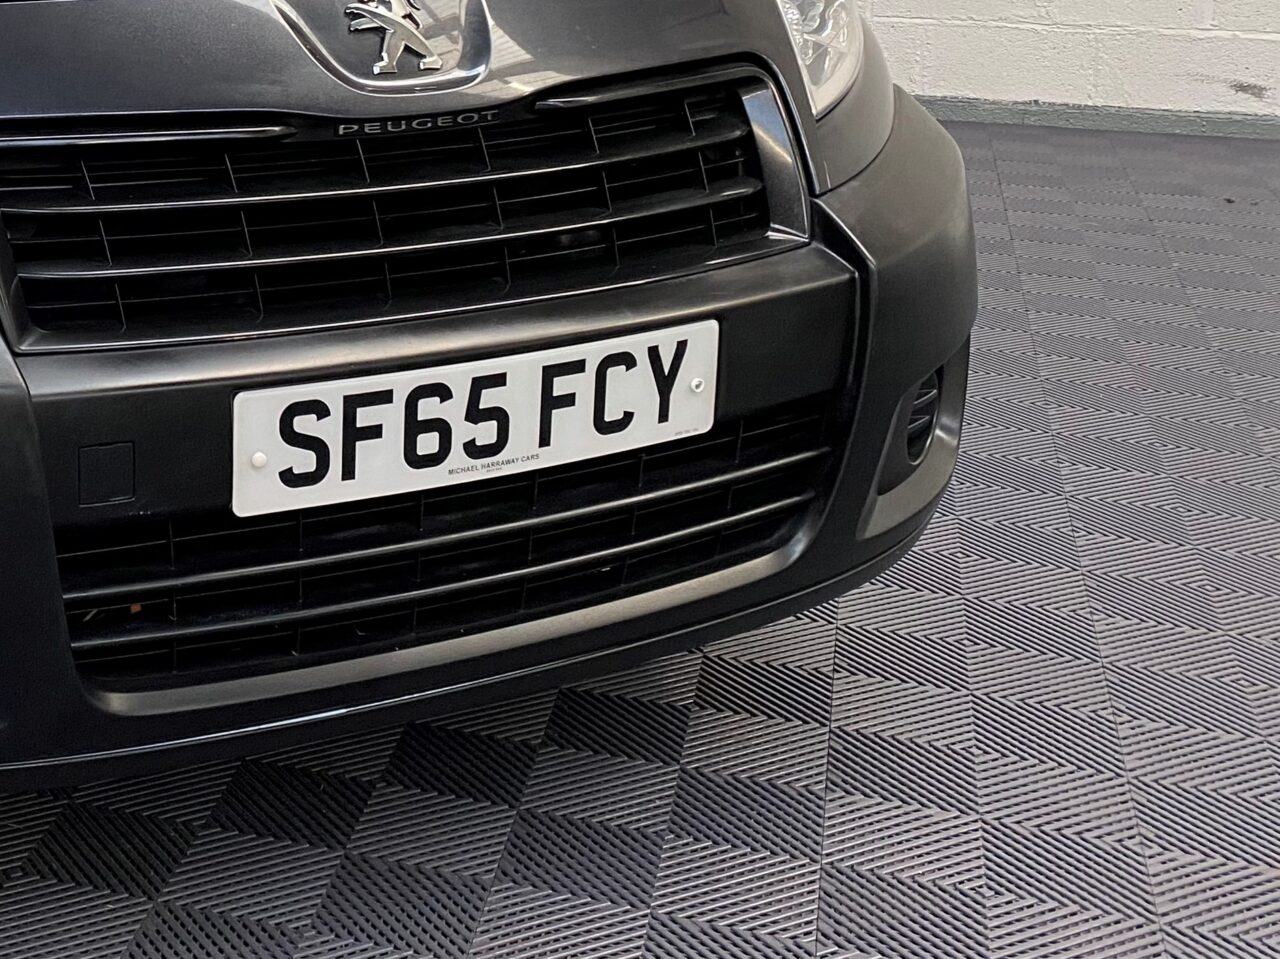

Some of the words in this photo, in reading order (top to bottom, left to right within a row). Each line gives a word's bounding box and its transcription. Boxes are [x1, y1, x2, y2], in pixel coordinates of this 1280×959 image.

[338, 110, 499, 135] PEUGEOT
[278, 372, 510, 489] SF65
[538, 339, 688, 448] FCY
[448, 465, 479, 475] MICHAEL
[481, 457, 519, 470] HARRAWAY
[520, 453, 540, 463] CARS
